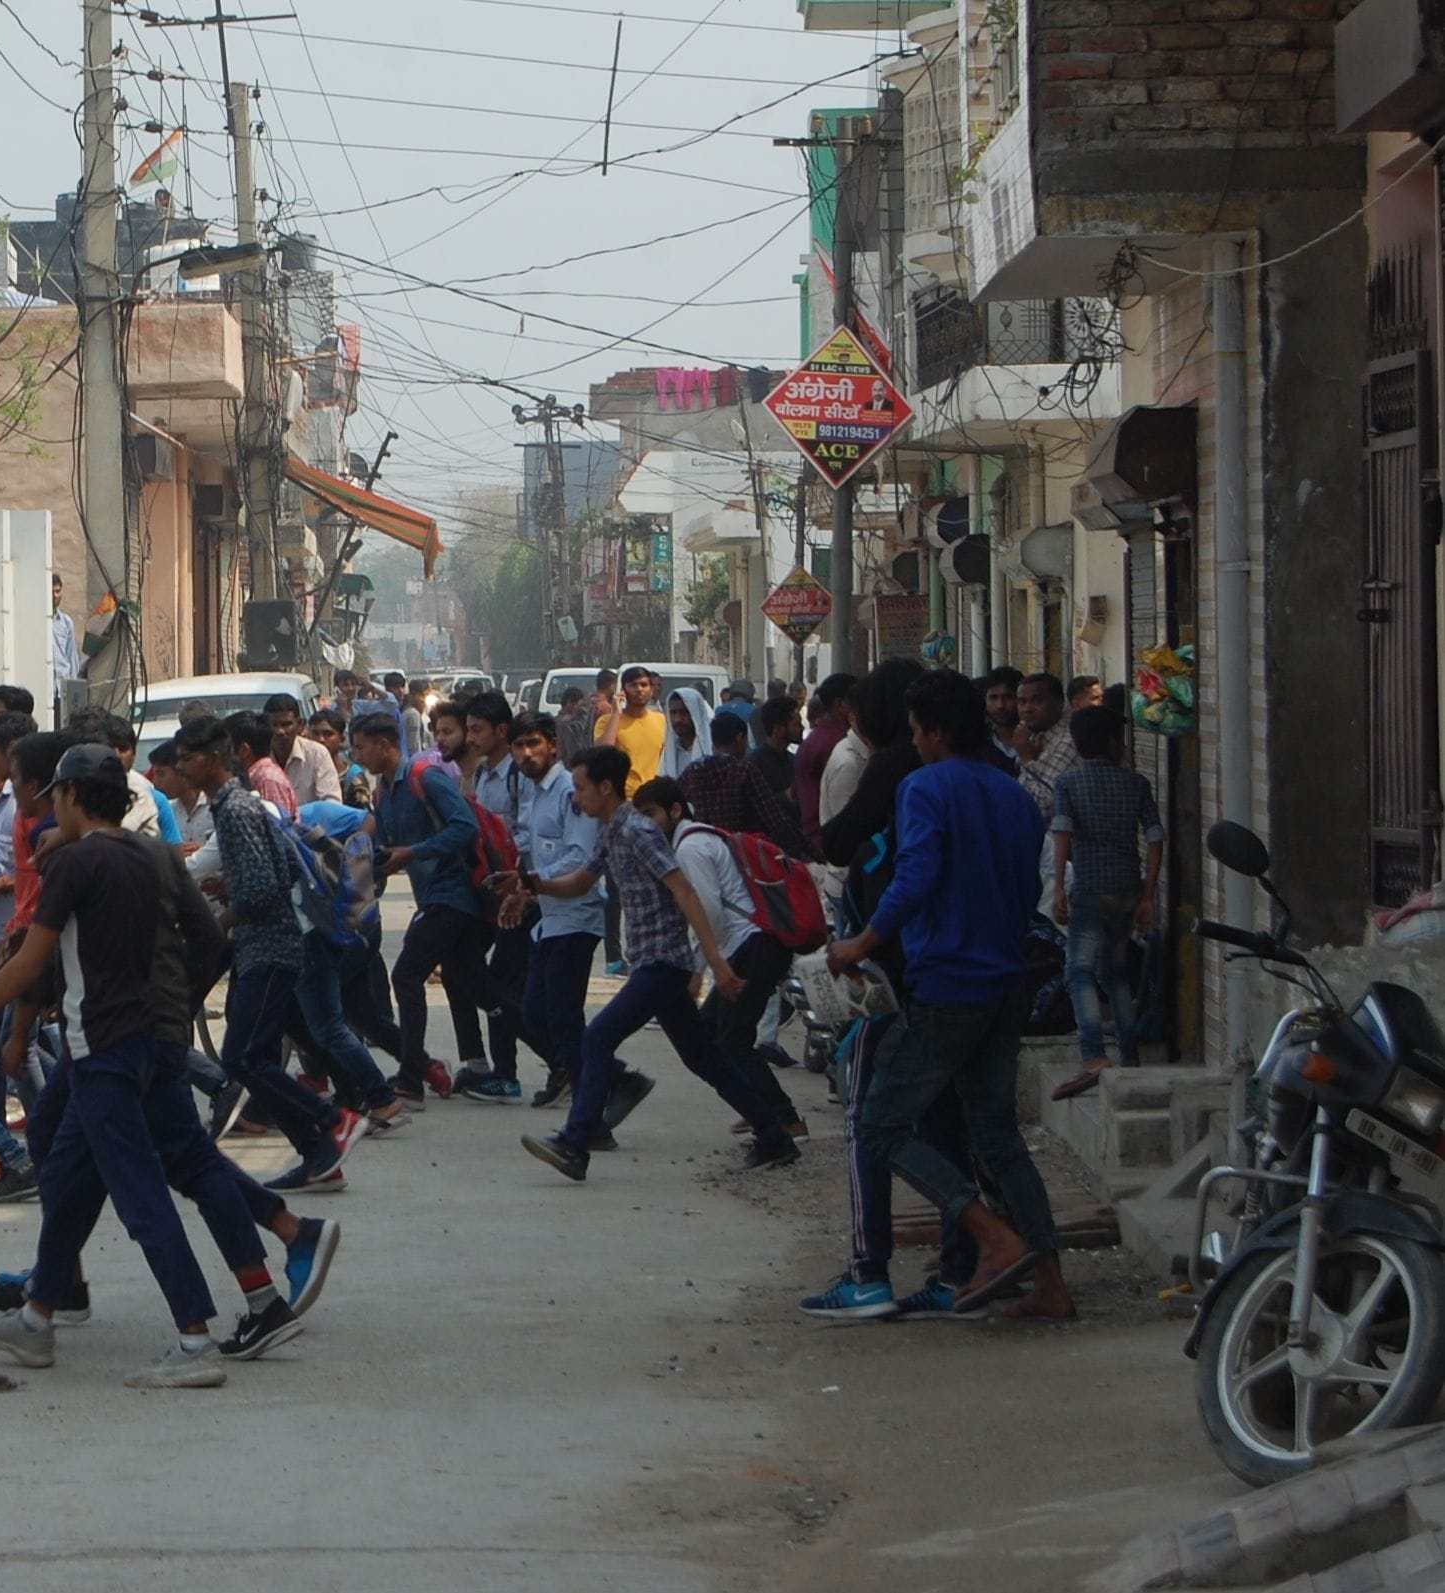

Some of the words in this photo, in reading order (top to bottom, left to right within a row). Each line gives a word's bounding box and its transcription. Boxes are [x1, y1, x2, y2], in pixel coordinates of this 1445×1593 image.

[845, 366, 871, 374] VIEWS
[784, 376, 855, 403] अंग्रेजी
[775, 400, 821, 417] बोलना
[823, 402, 862, 420] सीखें
[818, 424, 880, 440] 9812194251
[814, 442, 860, 459] ACE
